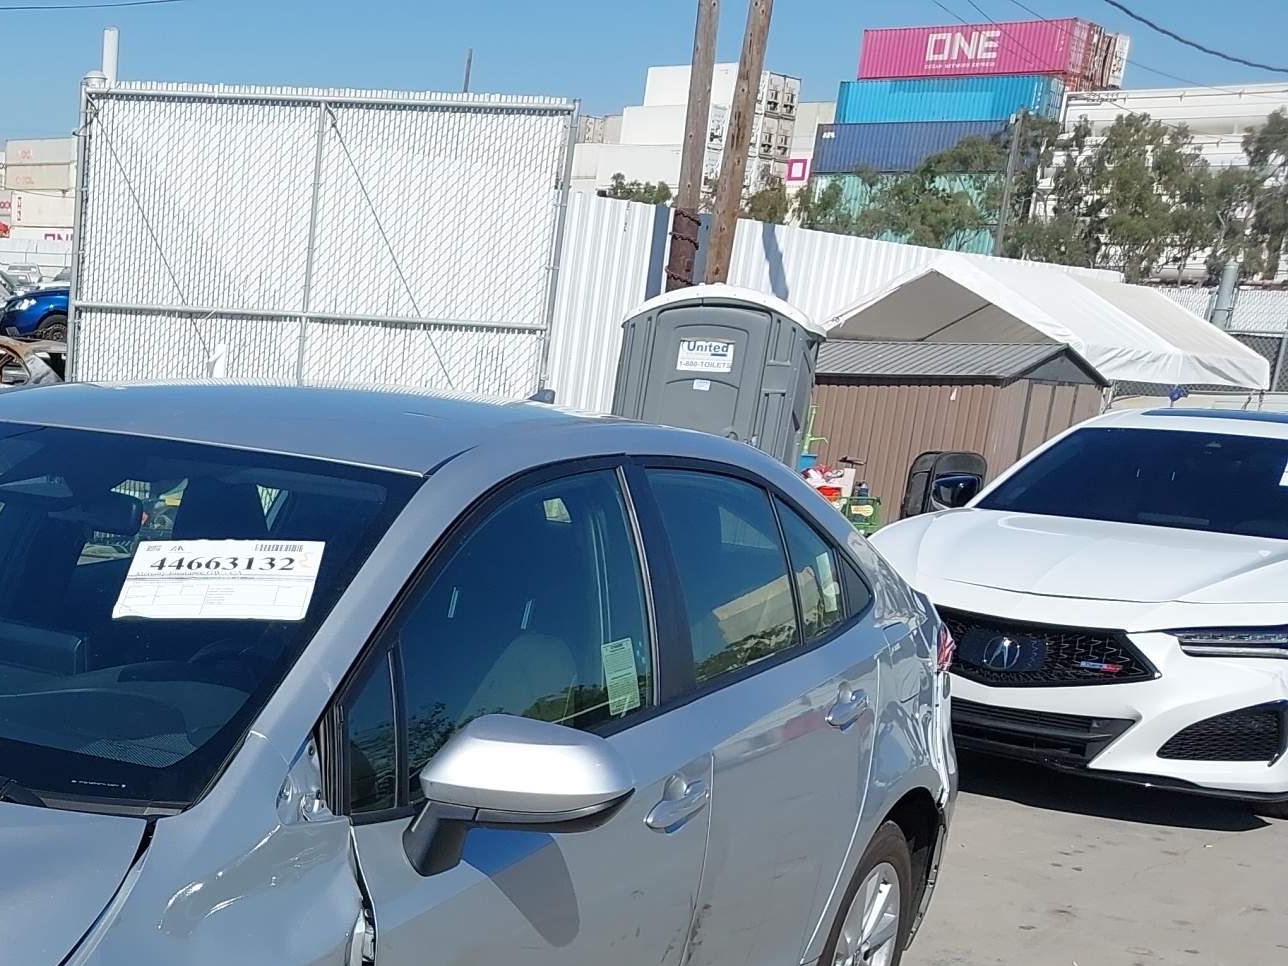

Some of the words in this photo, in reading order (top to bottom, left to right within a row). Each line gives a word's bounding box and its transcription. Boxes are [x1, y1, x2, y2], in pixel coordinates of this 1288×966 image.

[925, 30, 1001, 61] ONE
[687, 341, 729, 353] United
[150, 556, 295, 571] 44663132
